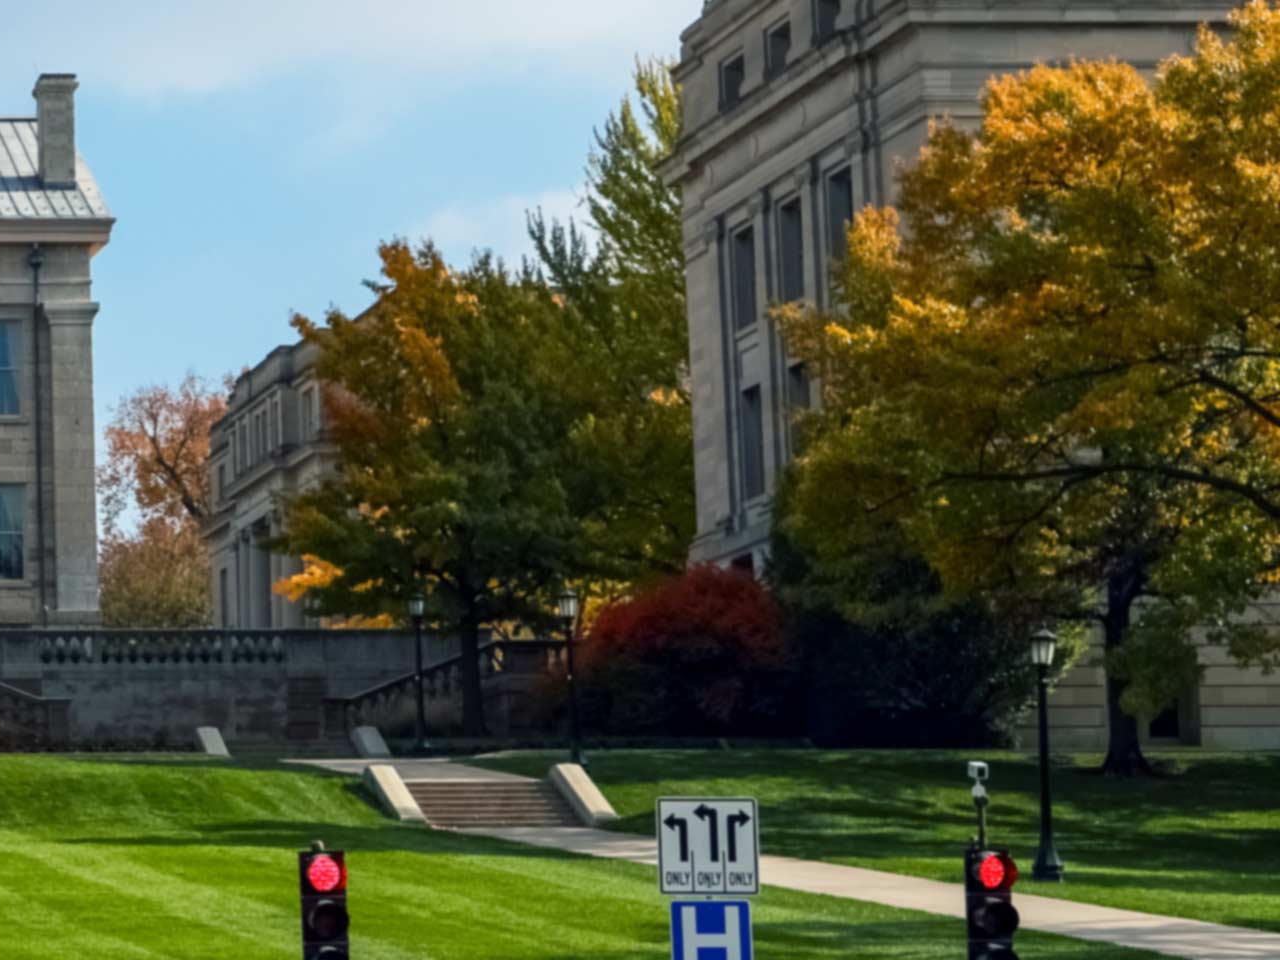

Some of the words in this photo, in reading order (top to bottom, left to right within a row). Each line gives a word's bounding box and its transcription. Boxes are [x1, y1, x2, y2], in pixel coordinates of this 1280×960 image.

[666, 872, 691, 886] ONLY
[697, 872, 722, 886] ONLY
[729, 872, 753, 886] ONLY
[681, 905, 742, 960] H
